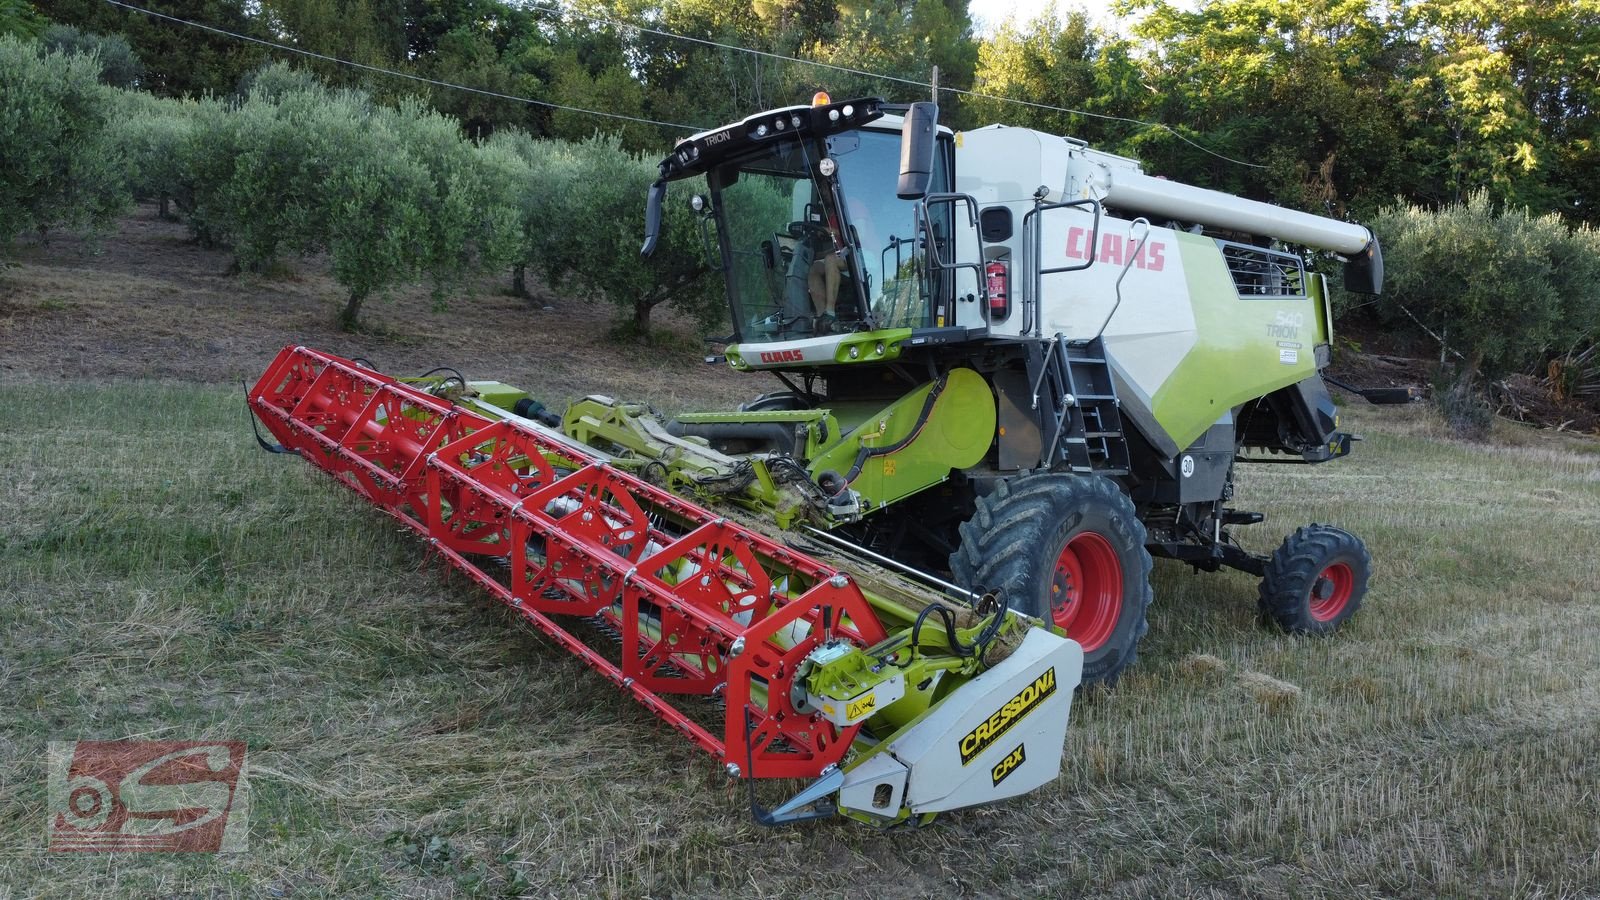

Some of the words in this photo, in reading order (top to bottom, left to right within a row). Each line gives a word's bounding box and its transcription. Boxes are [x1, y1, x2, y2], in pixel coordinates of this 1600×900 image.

[704, 130, 731, 147] TRION
[1065, 226, 1166, 272] CLAAS
[1275, 310, 1303, 328] 540
[1266, 324, 1298, 340] TRION
[760, 349, 804, 364] CLAAS
[1183, 459, 1193, 474] 30
[993, 745, 1024, 781] CRX
